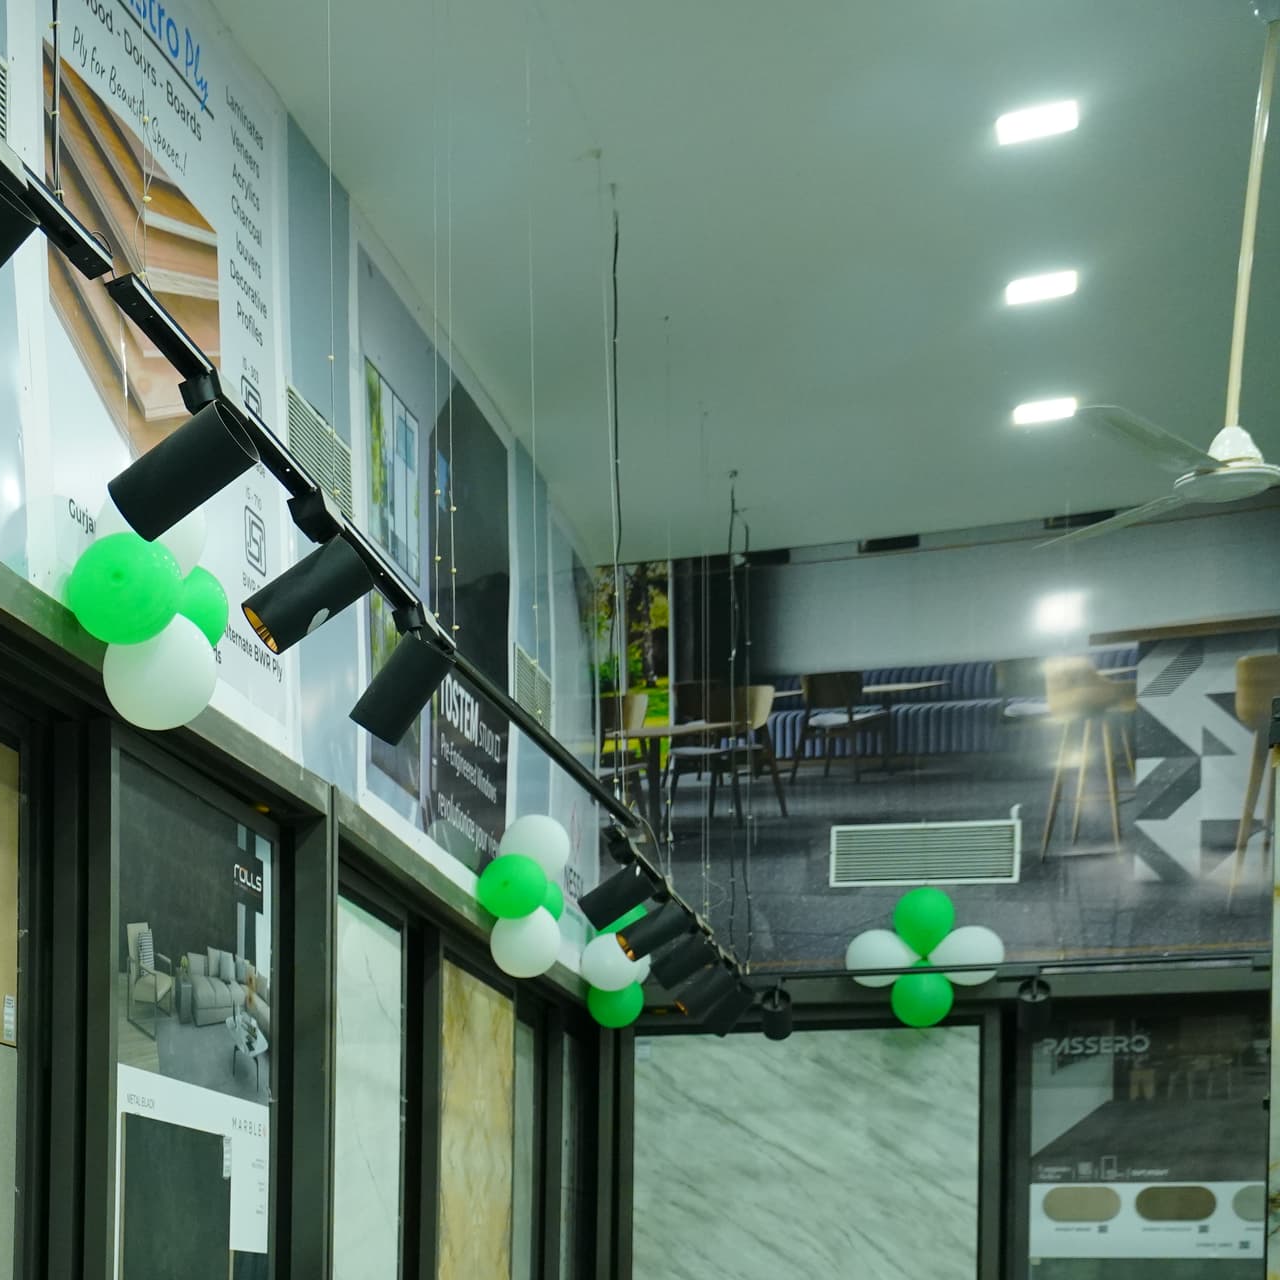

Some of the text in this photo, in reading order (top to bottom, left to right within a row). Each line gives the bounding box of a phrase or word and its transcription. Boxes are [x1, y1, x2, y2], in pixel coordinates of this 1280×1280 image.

[72, 25, 88, 69] Ply
[90, 46, 106, 80] for
[165, 80, 203, 142] Boards
[225, 85, 264, 151] Laminates
[230, 125, 260, 179] Veneers
[232, 163, 260, 212] Acrylics
[231, 194, 263, 248] Charcoal
[230, 260, 268, 320] Decorative
[237, 301, 264, 347] Profiles
[68, 498, 96, 534] Gurja
[254, 645, 271, 671] BWR
[272, 658, 283, 683] Ply
